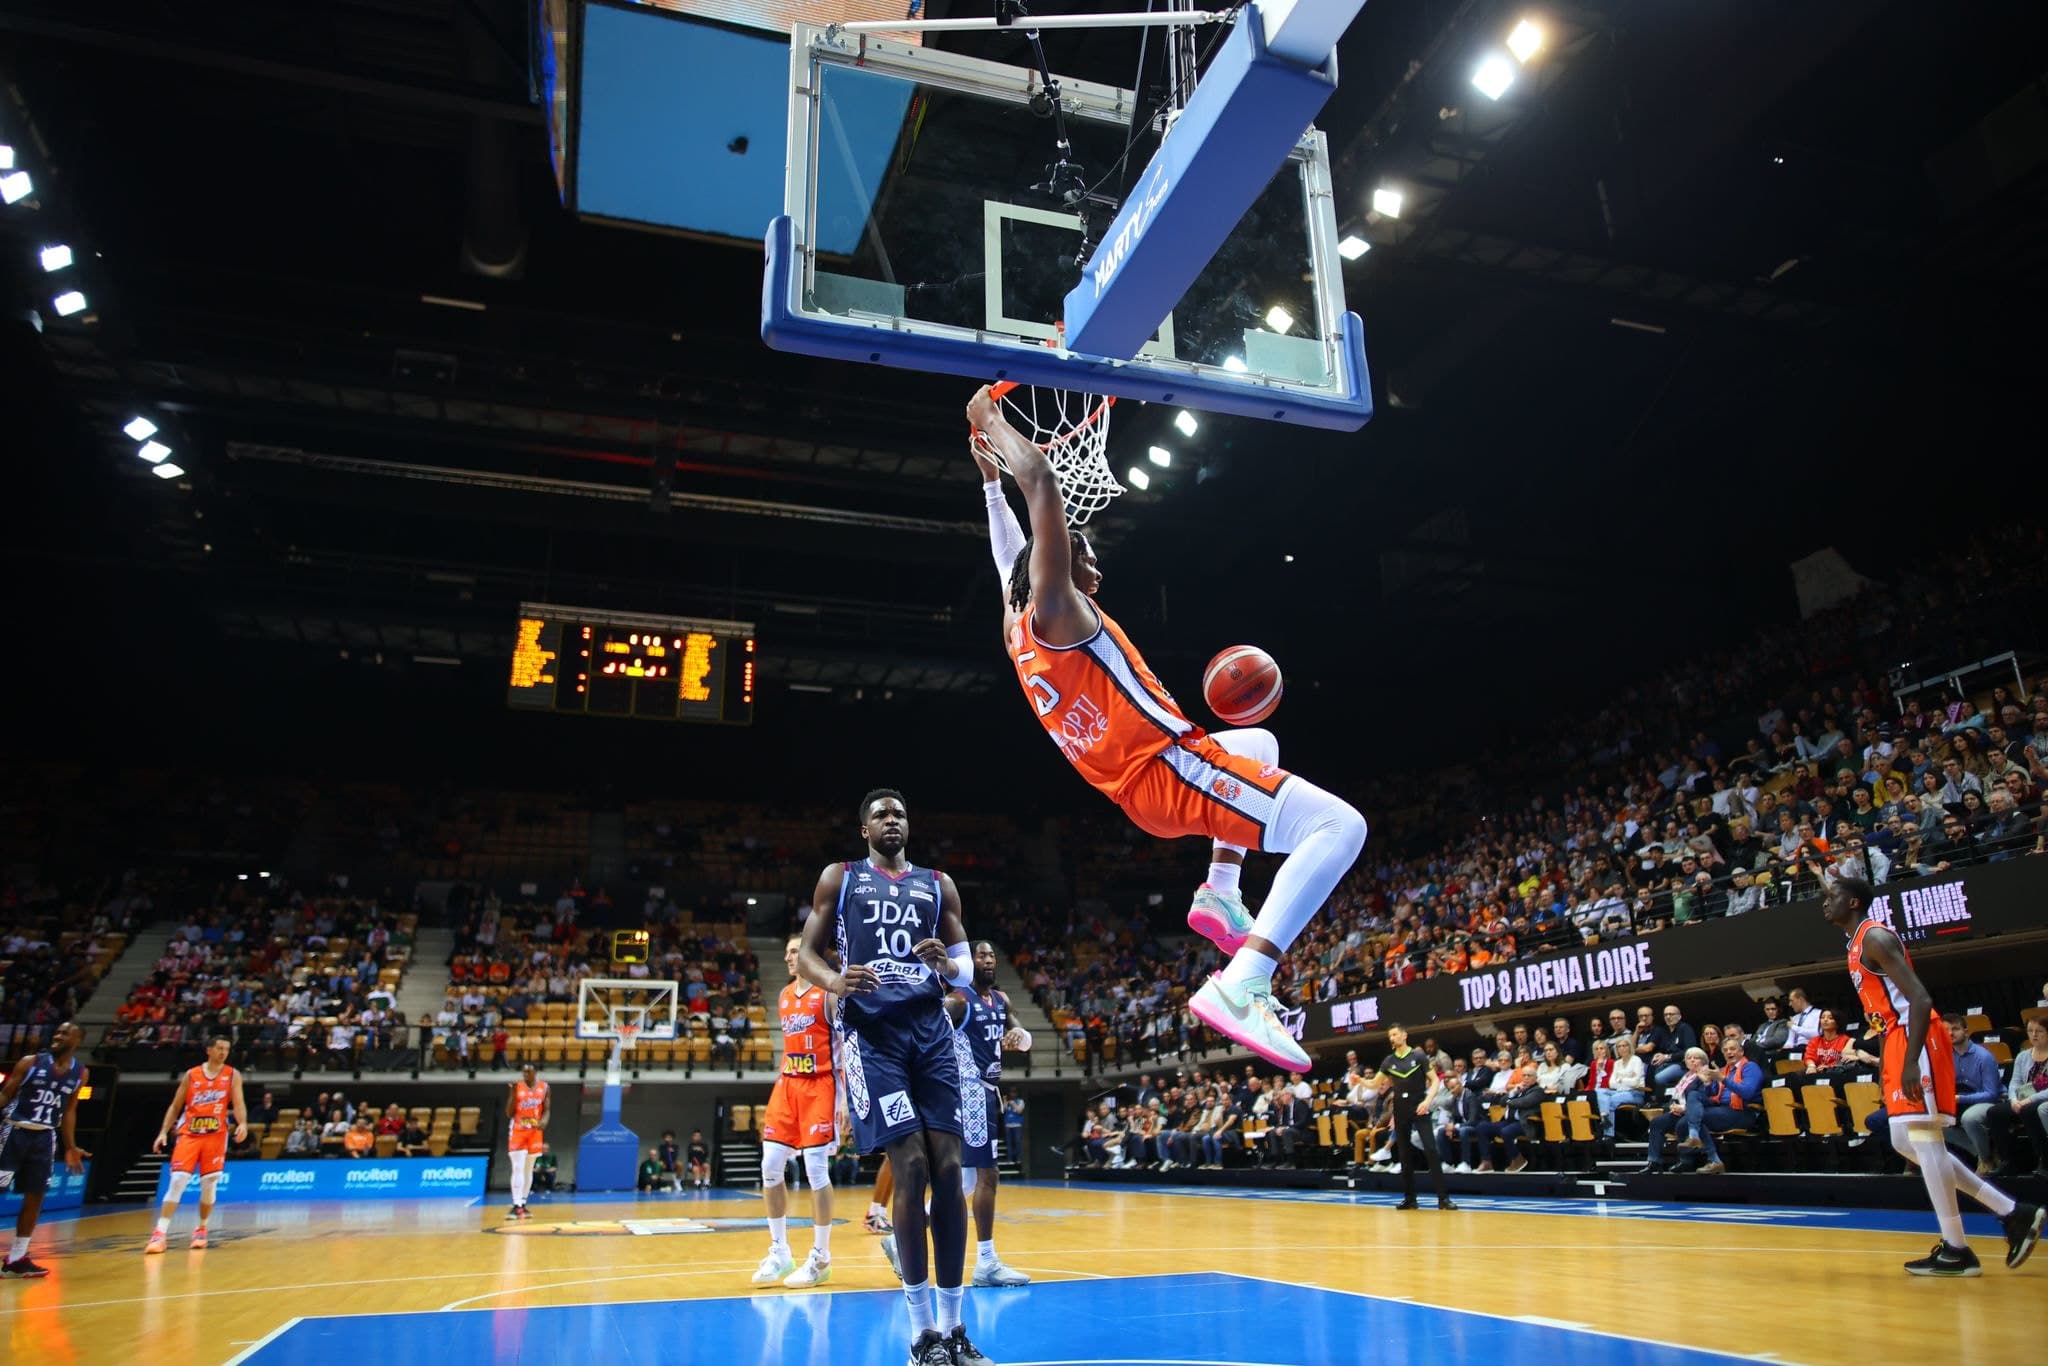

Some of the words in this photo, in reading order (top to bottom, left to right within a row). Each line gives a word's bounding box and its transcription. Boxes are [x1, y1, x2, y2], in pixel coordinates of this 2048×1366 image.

[1095, 200, 1143, 299] MARTY
[863, 900, 922, 928] JDA
[1900, 880, 1972, 929] FRANCE
[875, 927, 912, 958] 10
[1459, 974, 1496, 1012] TOP
[1498, 969, 1513, 1005] 8
[1514, 956, 1586, 1004] ARENA
[1585, 942, 1654, 990] LOIRE
[30, 1089, 62, 1109] JDA
[31, 1105, 53, 1124] 11
[262, 1169, 315, 1184] molten
[346, 1167, 398, 1182] molten
[422, 1166, 473, 1180] molten
